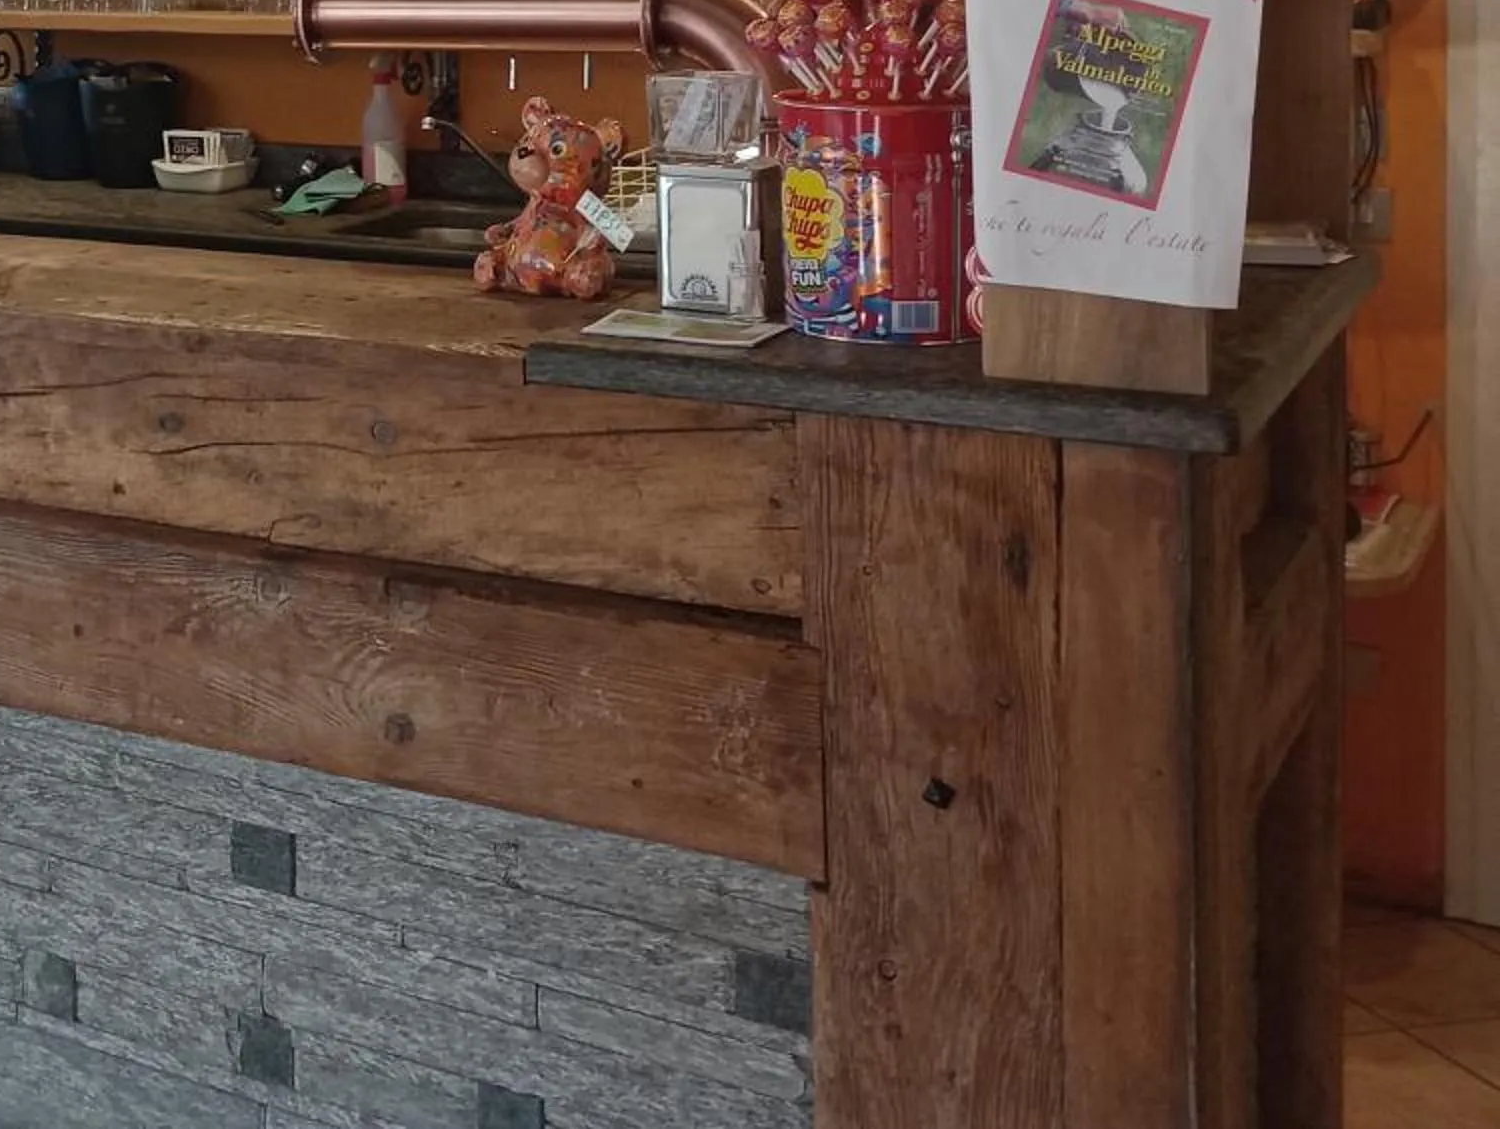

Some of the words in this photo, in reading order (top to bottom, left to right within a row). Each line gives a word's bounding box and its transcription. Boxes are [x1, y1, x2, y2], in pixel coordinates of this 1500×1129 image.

[1077, 23, 1166, 63] Alpeggi
[1055, 50, 1173, 97] Valmalenco
[785, 186, 834, 215] Chupa
[791, 271, 821, 286] FUN
